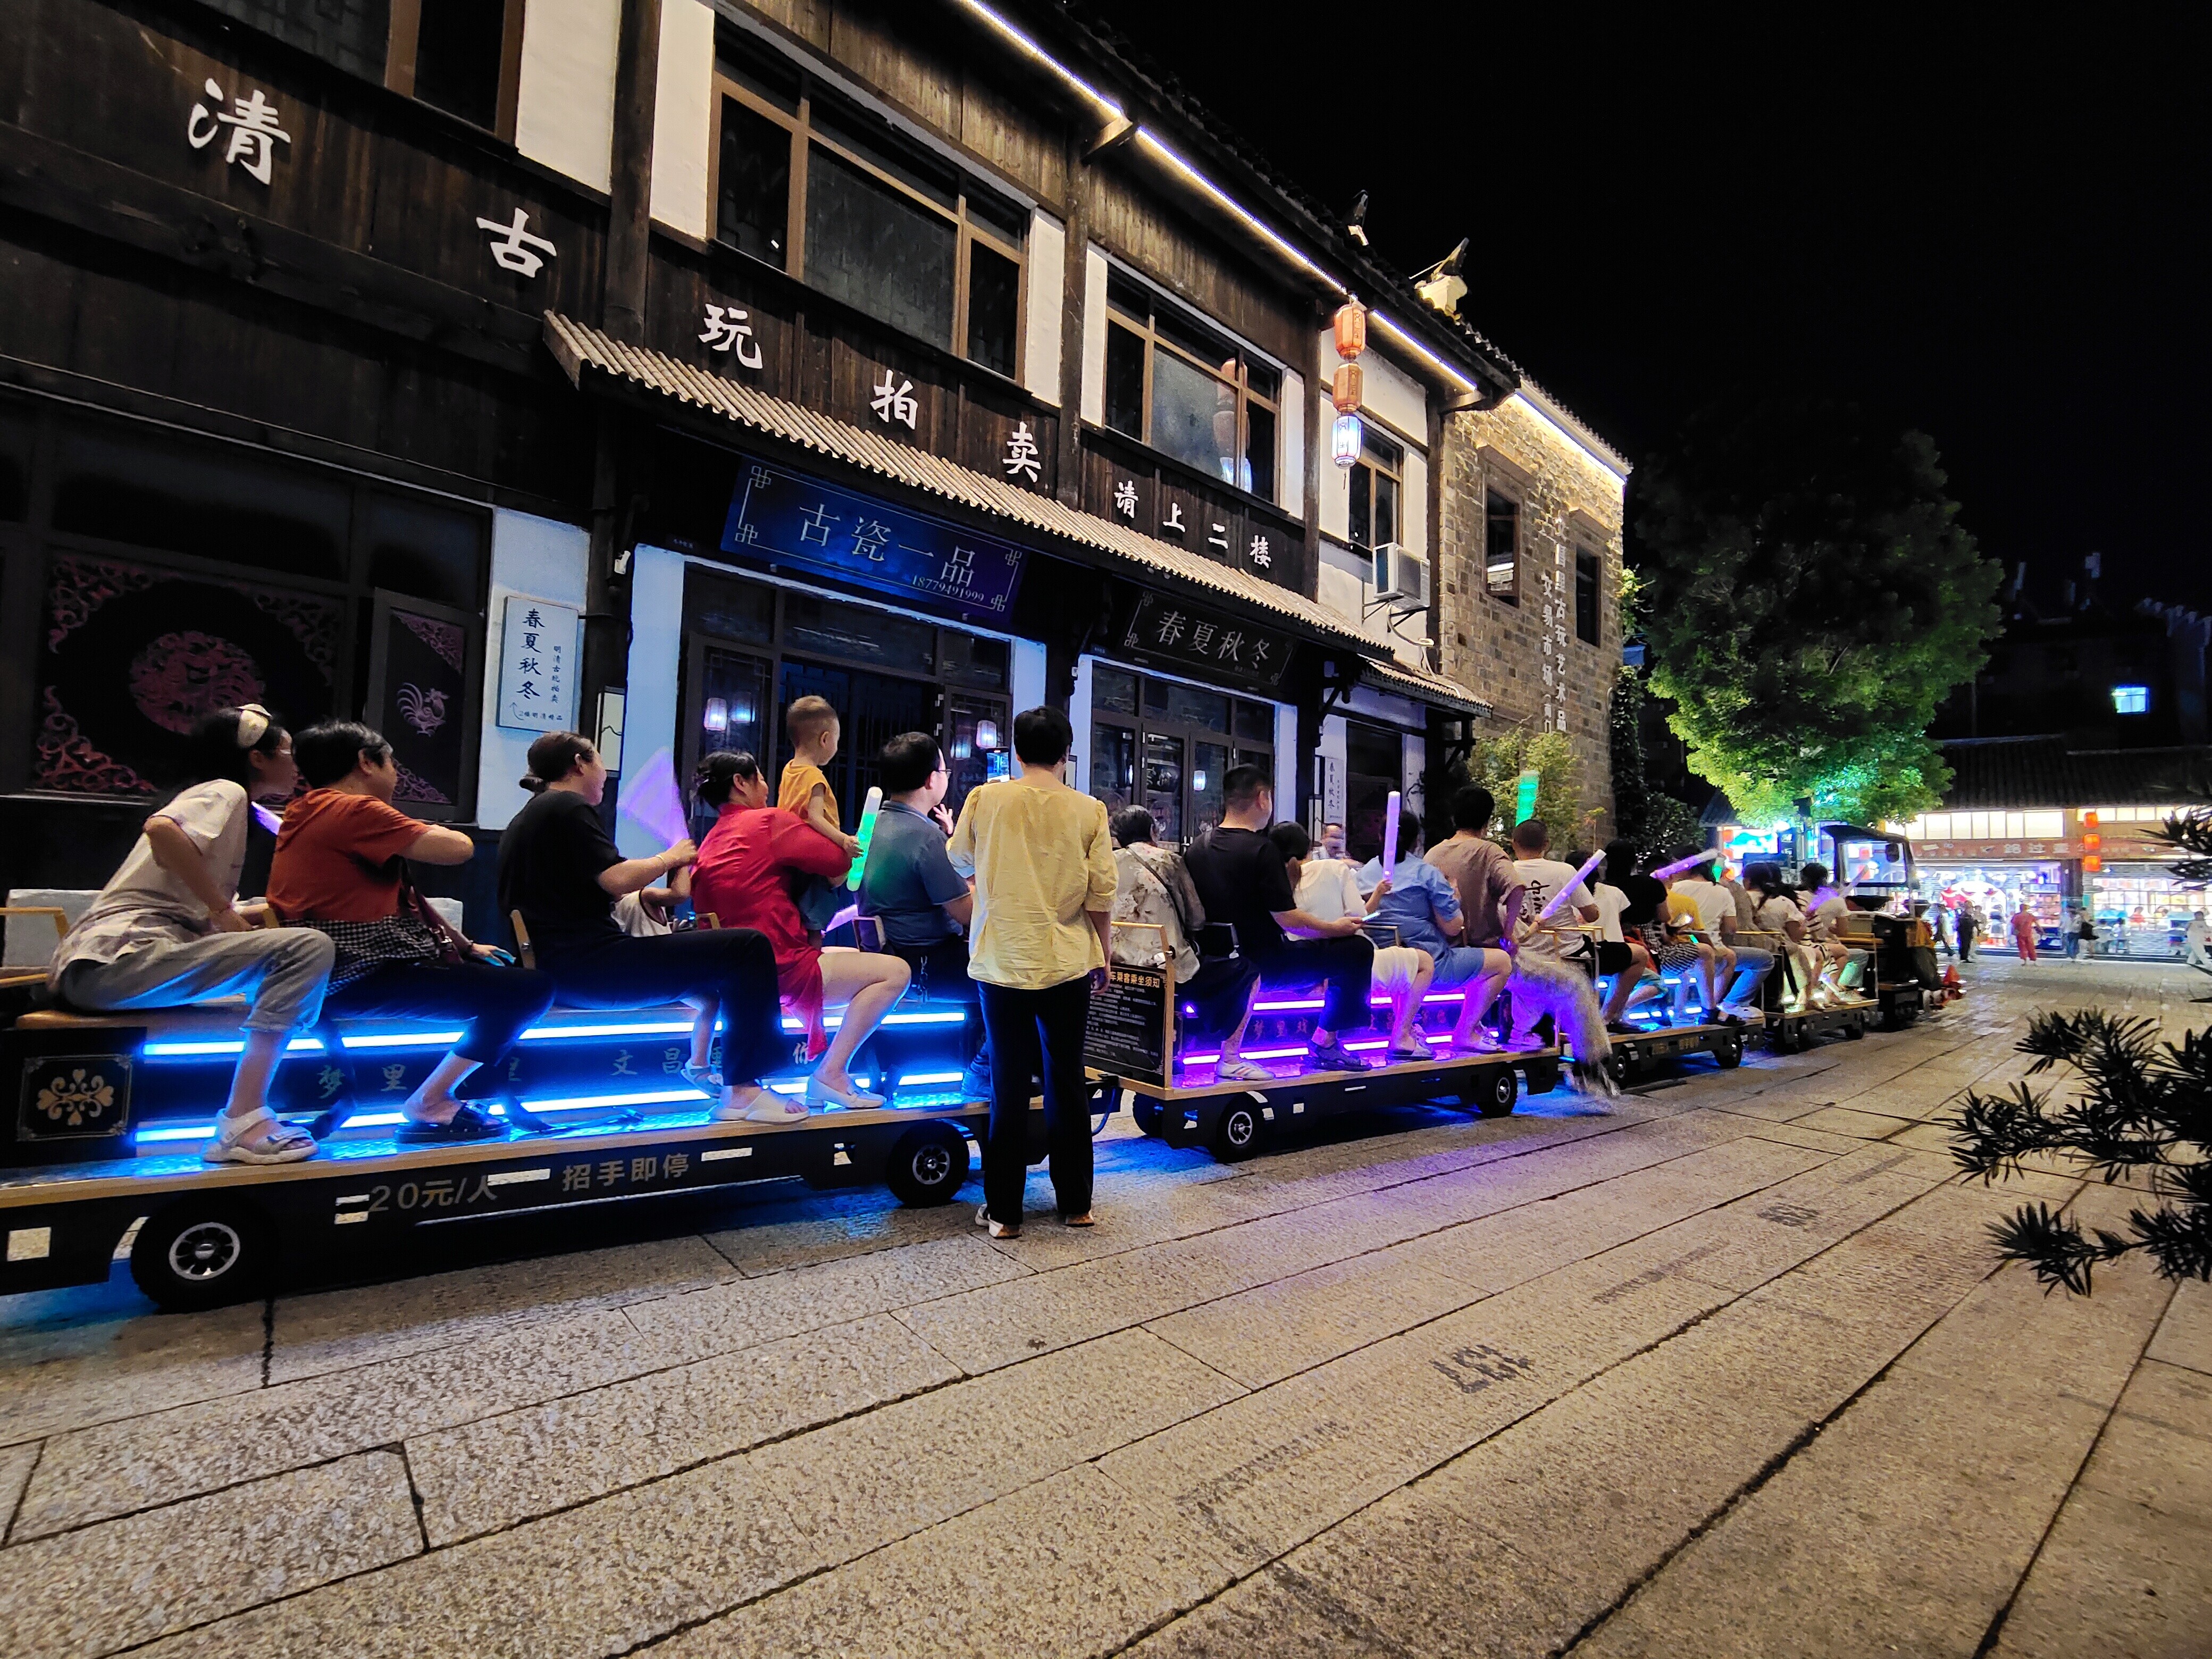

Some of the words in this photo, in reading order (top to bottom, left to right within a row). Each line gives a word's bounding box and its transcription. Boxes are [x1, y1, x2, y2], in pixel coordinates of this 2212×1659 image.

[799, 503, 976, 586] 古瓷一品
[1113, 481, 1272, 568] 请上二楼
[912, 575, 984, 603] 18779491999
[516, 607, 546, 700] 春夏秋冬
[1157, 610, 1271, 670] 春夏秋冬
[563, 1153, 690, 1192] 招手即停
